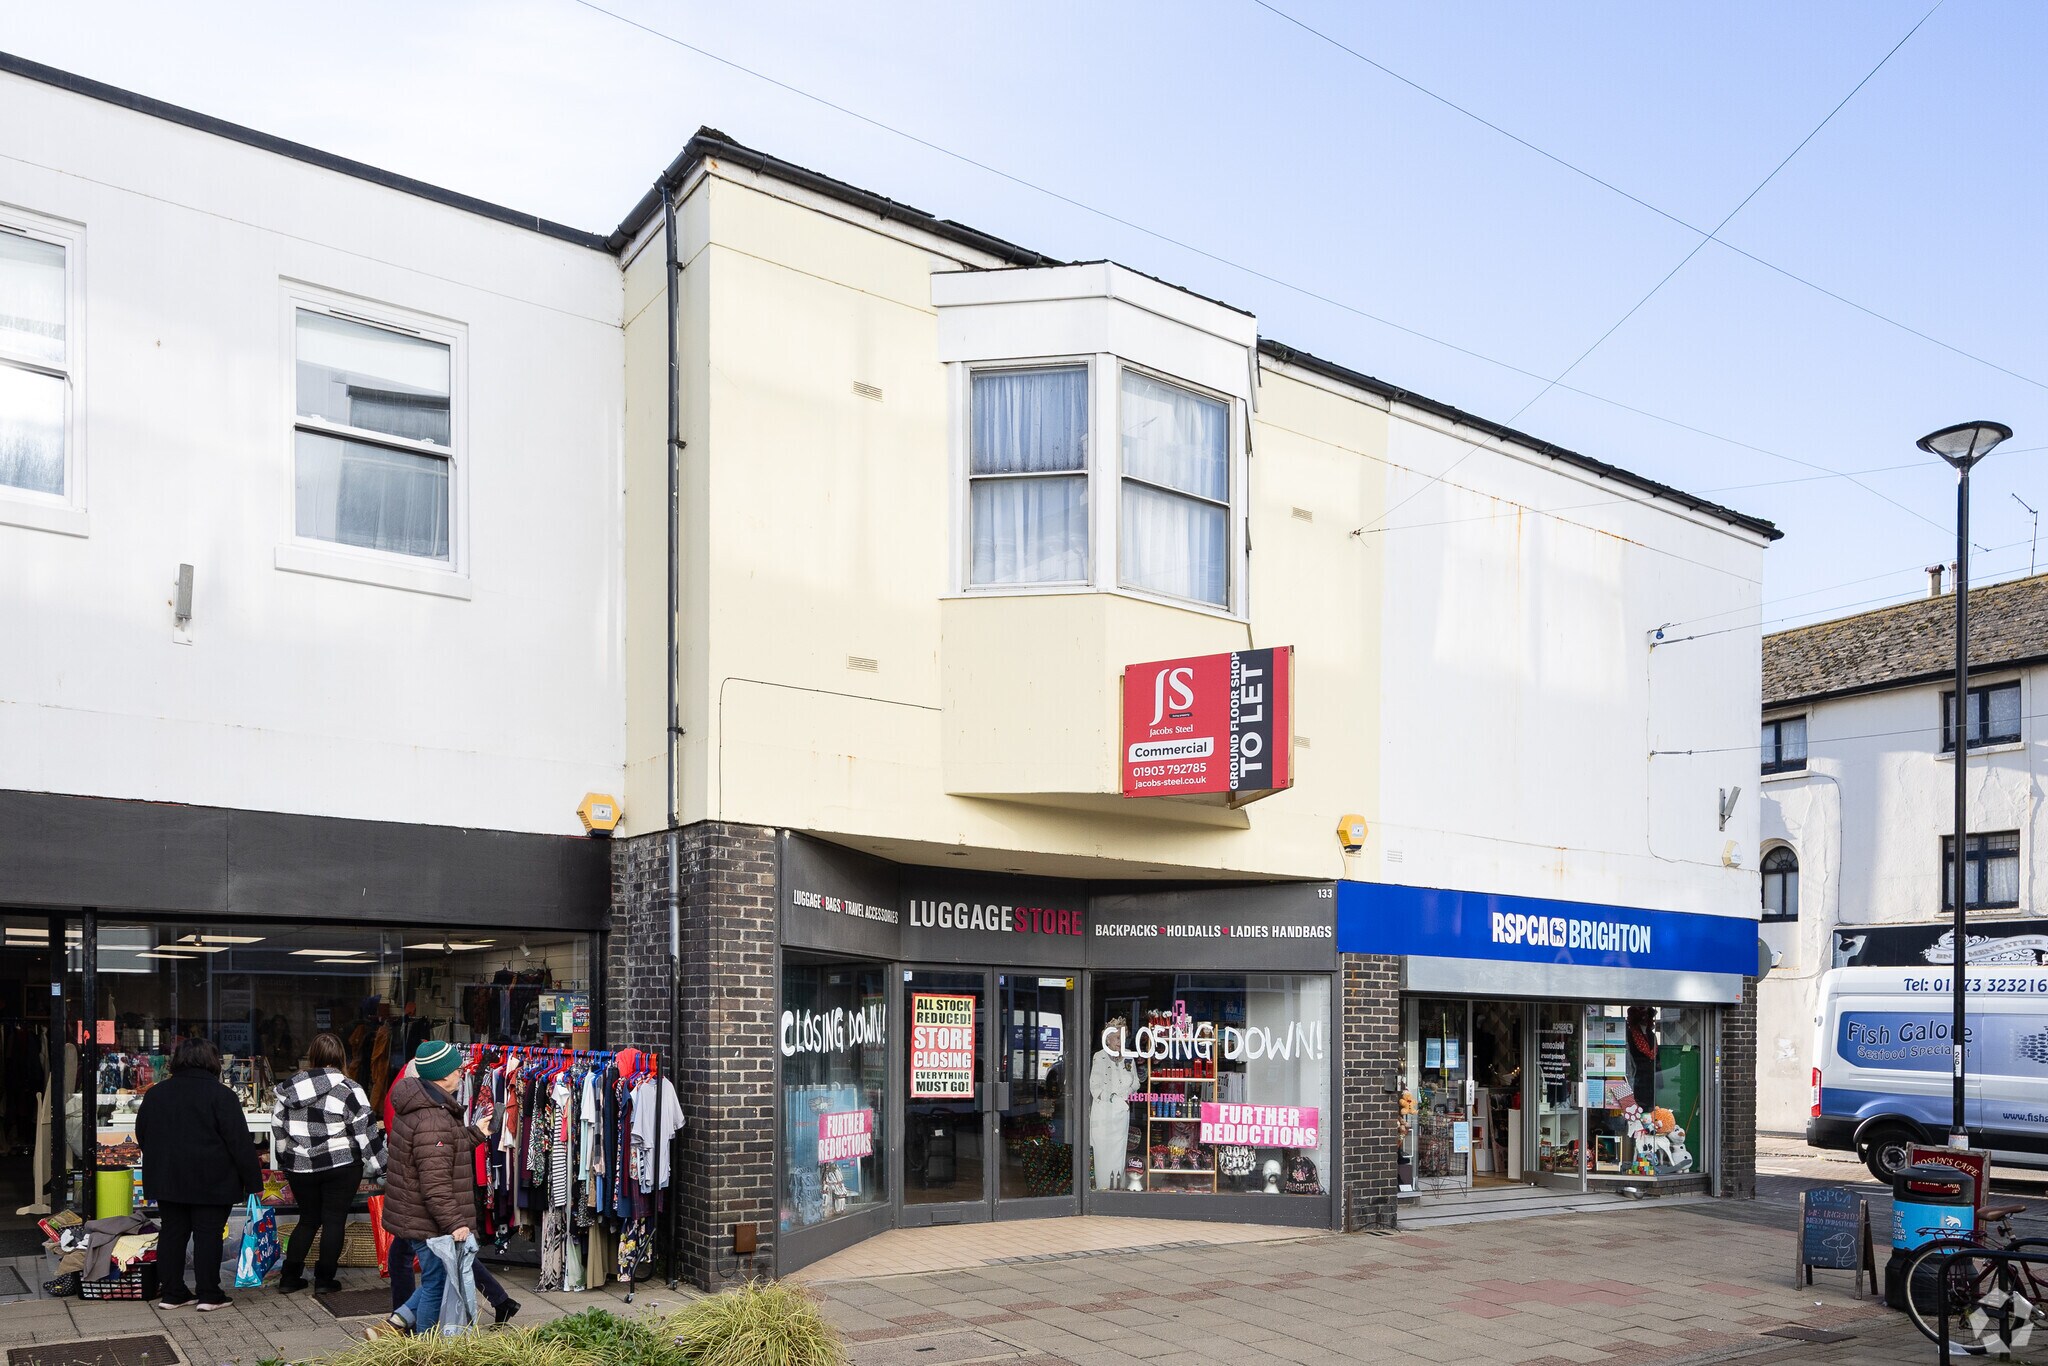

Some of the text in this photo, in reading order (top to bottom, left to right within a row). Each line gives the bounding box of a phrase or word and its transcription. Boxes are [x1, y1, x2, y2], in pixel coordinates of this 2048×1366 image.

[1229, 652, 1241, 789] GROUND FLOOR SHOP
[1240, 663, 1263, 778] TO LET
[1149, 724, 1194, 738] Jacobs Steel
[1135, 742, 1207, 758] Commercial
[1133, 762, 1207, 777] 01903 792785
[1135, 776, 1207, 789] jacobs-steel.co.uk
[1317, 889, 1332, 899] 133
[793, 889, 898, 924] LUGGAGE BAGS TRAVEL ACCESSORIES
[1095, 924, 1332, 938] BACKPACKS HOLDALLS LADIES HANDBAGS
[1492, 912, 1651, 954] RSPCA BRIGHTON
[1968, 944, 2004, 957] MEN'S
[2004, 939, 2042, 949] STYLE
[1904, 978, 2047, 992] Tel: 0173 323216
[916, 999, 971, 1011] ALL STOCK
[916, 1012, 972, 1025] REDUCED!
[780, 1004, 886, 1056] CLOSING DOWN!
[913, 1027, 972, 1050] STORE
[1848, 1021, 1890, 1044] Fish
[1101, 1023, 1214, 1060] CLOSING
[1224, 1020, 1323, 1060] DOWN!
[913, 1051, 972, 1068] CLOSING
[1857, 1043, 1971, 1060] Seafood Speciat
[915, 1072, 970, 1080] EVERYTHING
[916, 1081, 969, 1092] MUST GO!
[1160, 1093, 1185, 1103] ITEMS
[1219, 1105, 1300, 1126] FURTHER
[827, 1112, 864, 1137] FURTHER
[1201, 1123, 1318, 1147] REDUCTIONS
[818, 1132, 871, 1160] REDUCTIONS
[1954, 1160, 1980, 1177] CAFE
[1810, 1190, 1852, 1203] RSPCA
